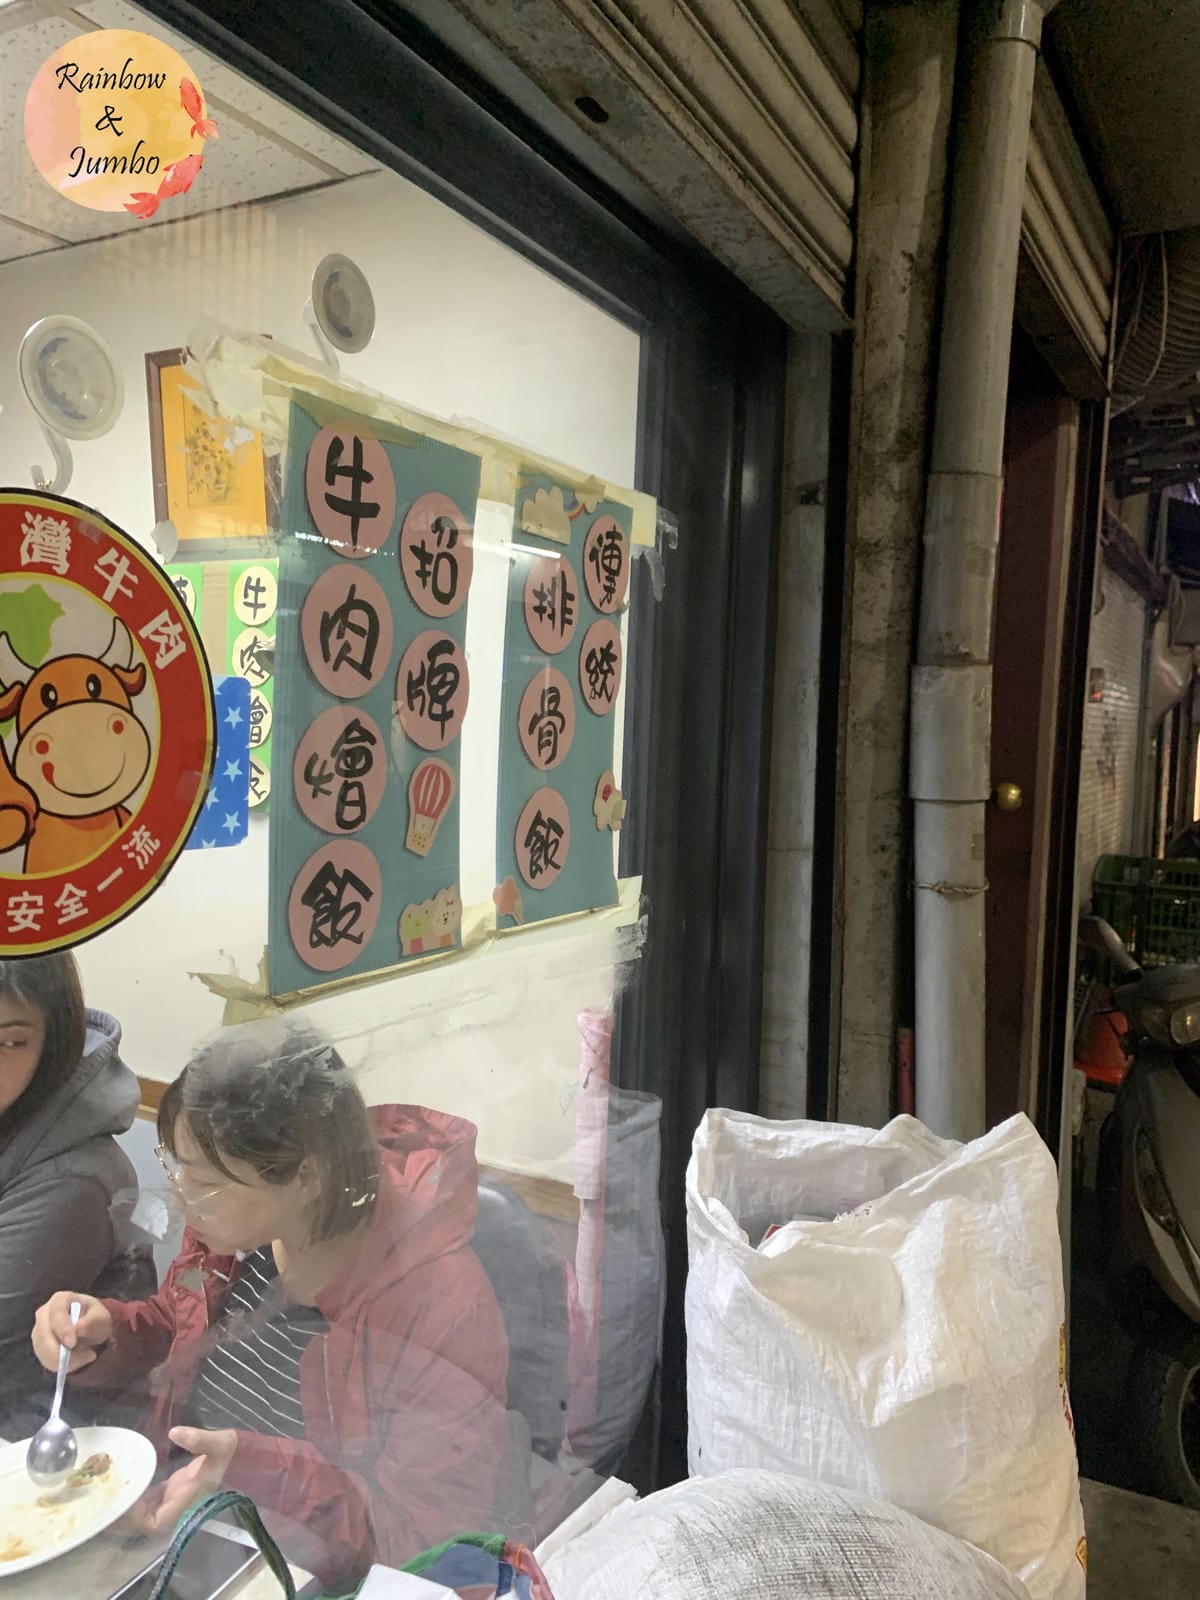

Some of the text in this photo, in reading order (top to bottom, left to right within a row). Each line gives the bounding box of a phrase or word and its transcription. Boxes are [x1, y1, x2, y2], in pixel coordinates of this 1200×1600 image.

[20, 511, 187, 670] 灣牛肉
[301, 434, 381, 949] 牛肉燴飯
[407, 515, 460, 741] 招牌
[585, 524, 623, 704] 傳統
[525, 570, 576, 879] 排骨飯
[6, 824, 161, 933] 安全一流
